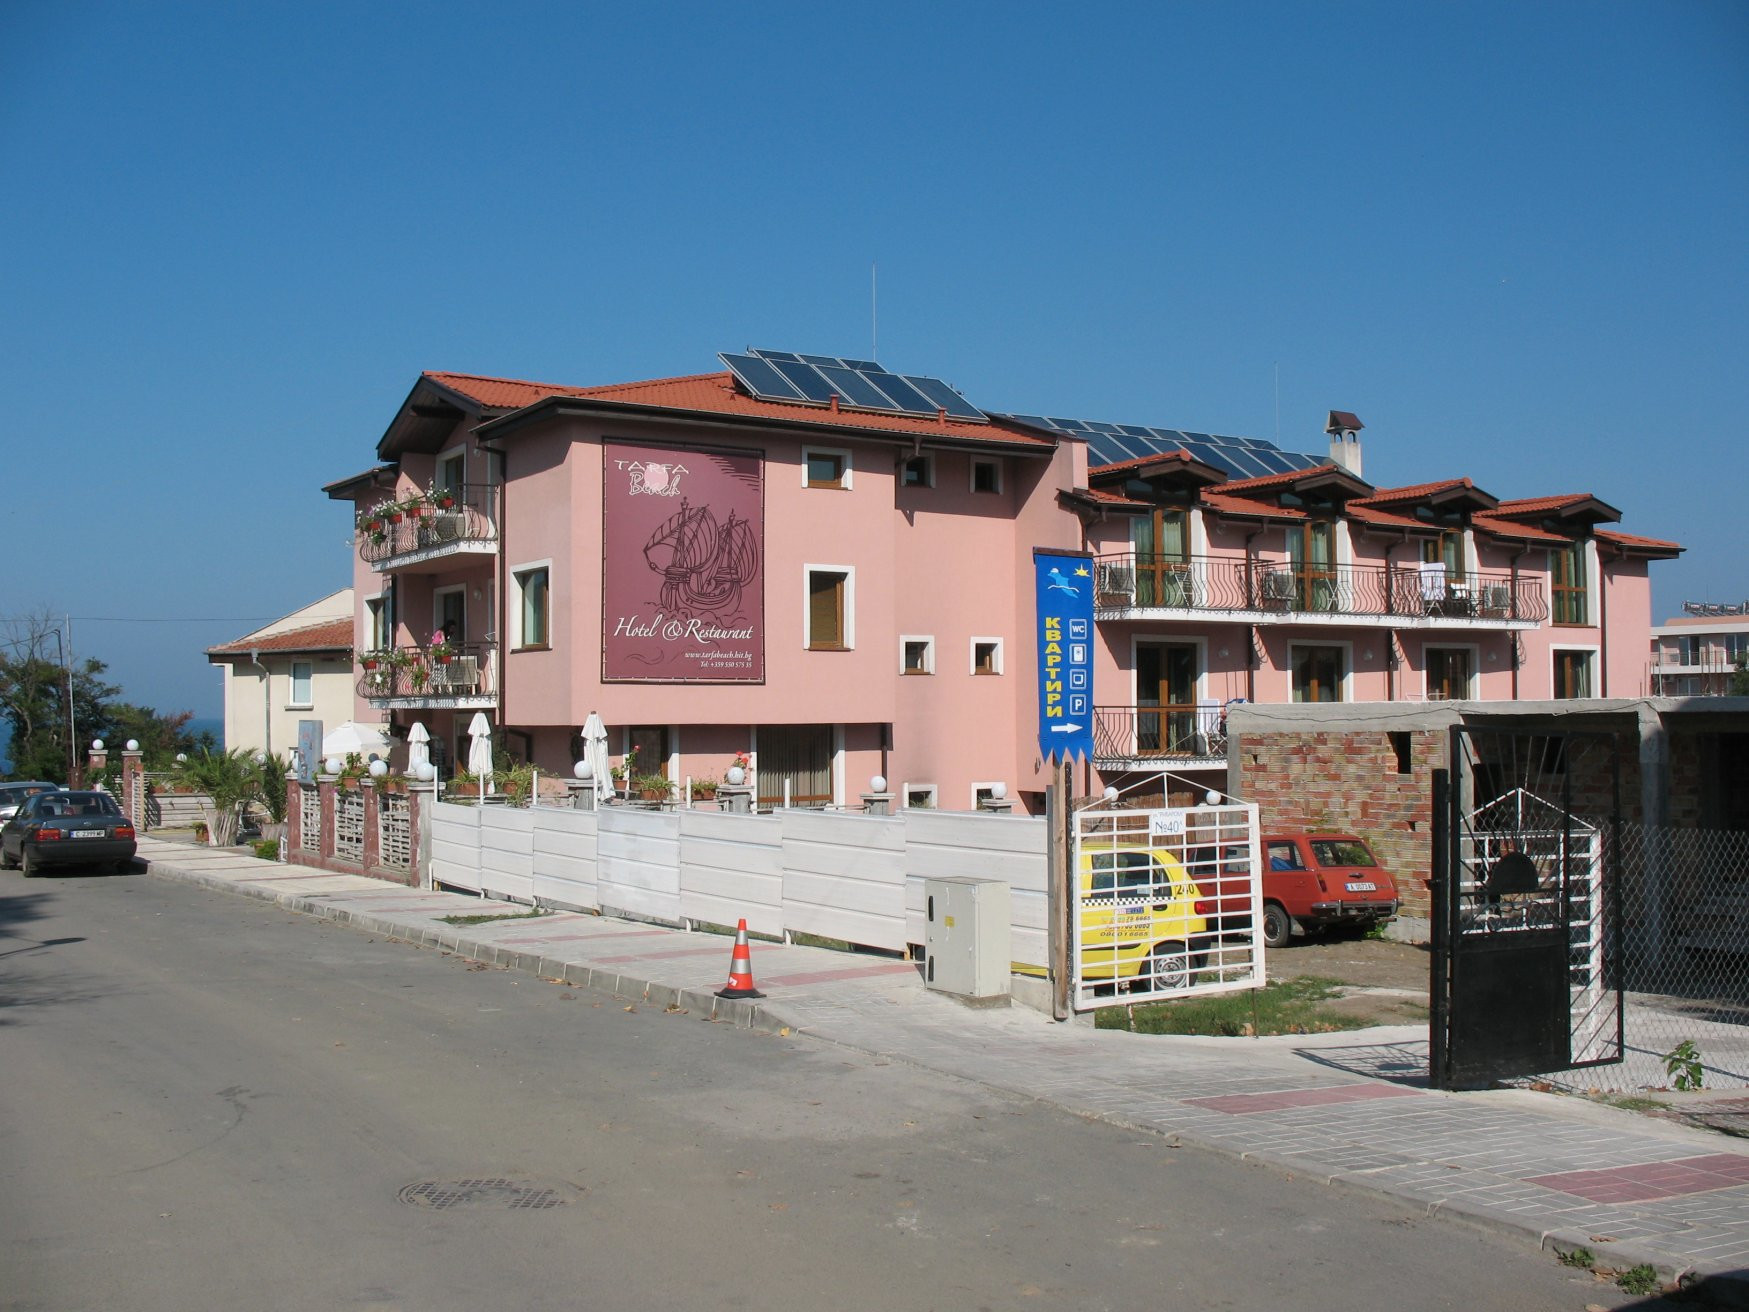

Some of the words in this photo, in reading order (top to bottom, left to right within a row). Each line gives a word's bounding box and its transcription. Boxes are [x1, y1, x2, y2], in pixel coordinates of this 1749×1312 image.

[613, 613, 664, 637] Hotel
[662, 619, 684, 641] &
[684, 618, 754, 644] Restaurant
[1071, 625, 1085, 633] WC
[1044, 616, 1063, 718] КВАРТИРИ
[1074, 698, 1083, 711] P
